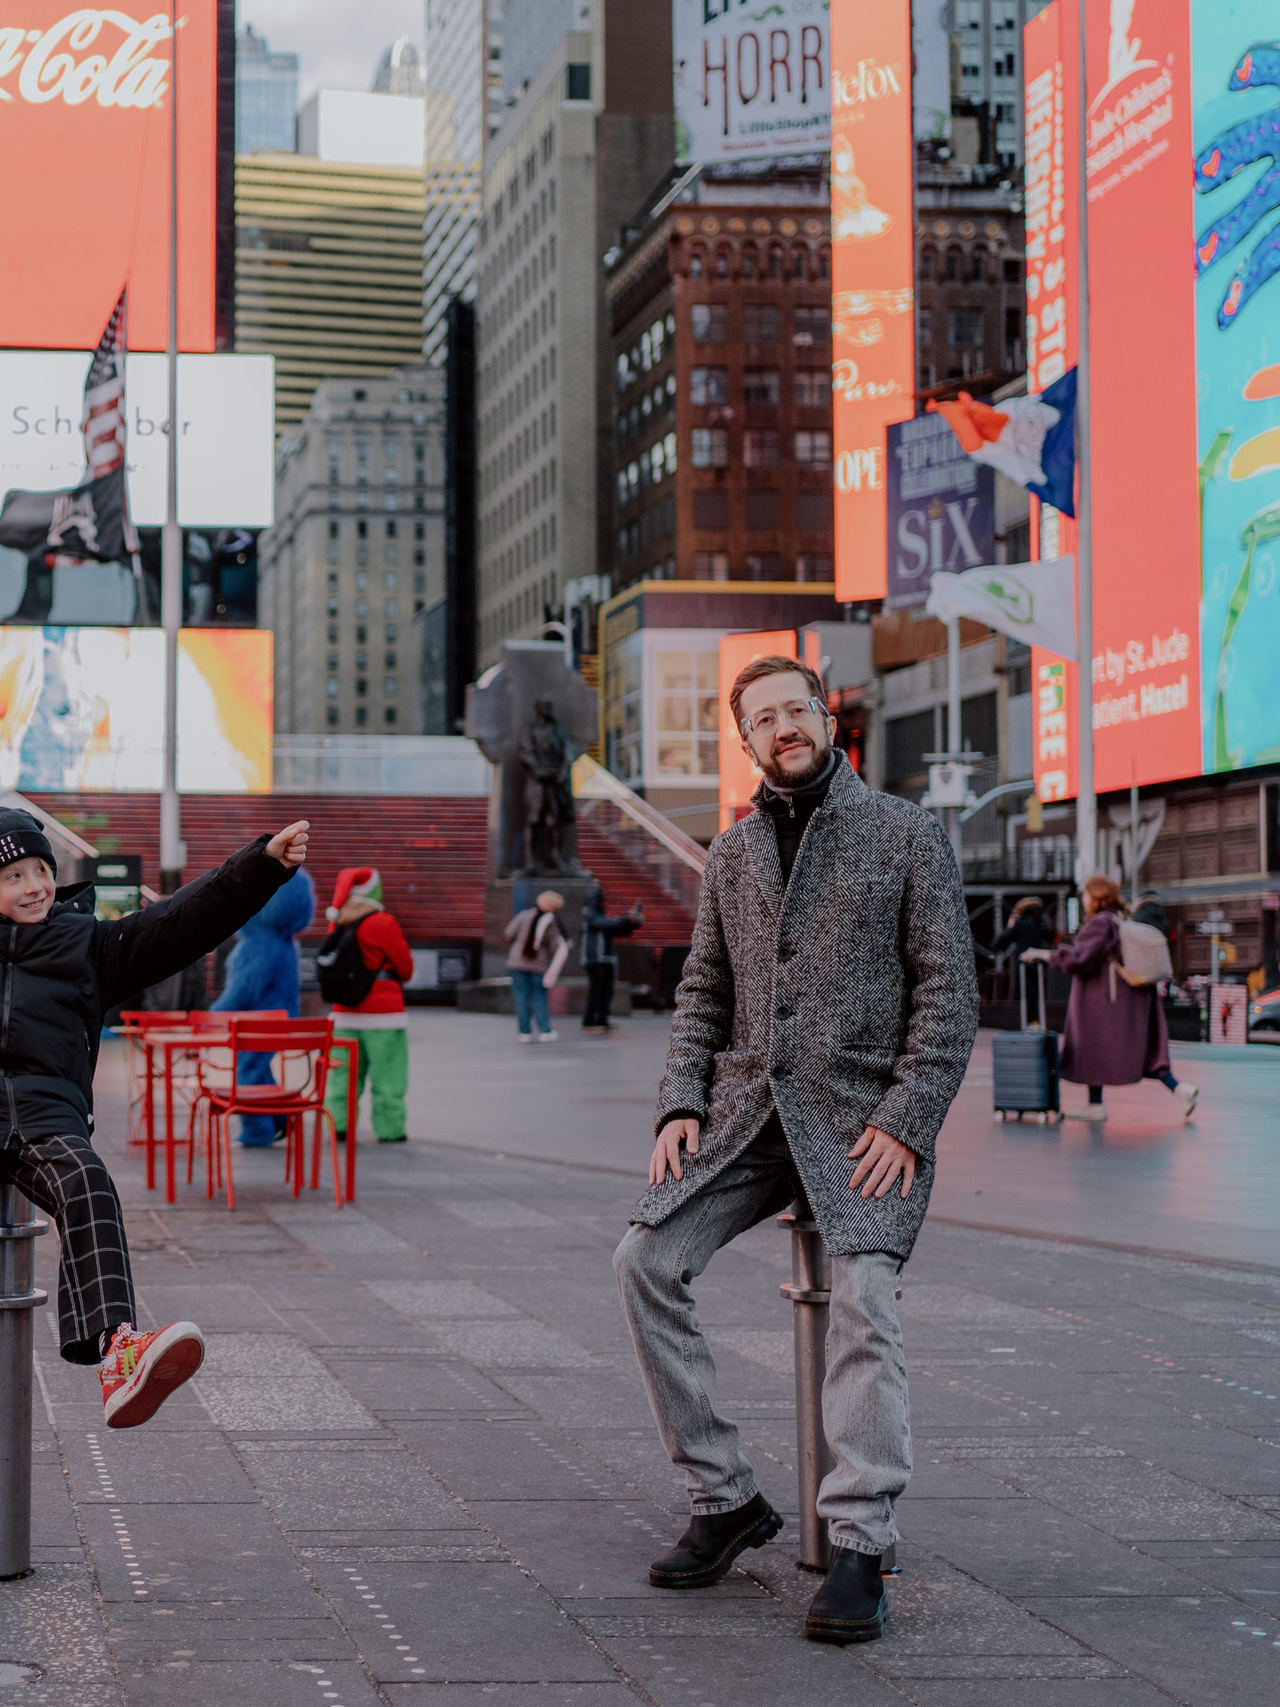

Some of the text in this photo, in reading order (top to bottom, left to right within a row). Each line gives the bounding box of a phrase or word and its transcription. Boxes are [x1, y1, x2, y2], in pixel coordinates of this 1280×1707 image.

[1092, 673, 1188, 731] atient, Hazel
[0, 847, 25, 863] TION
